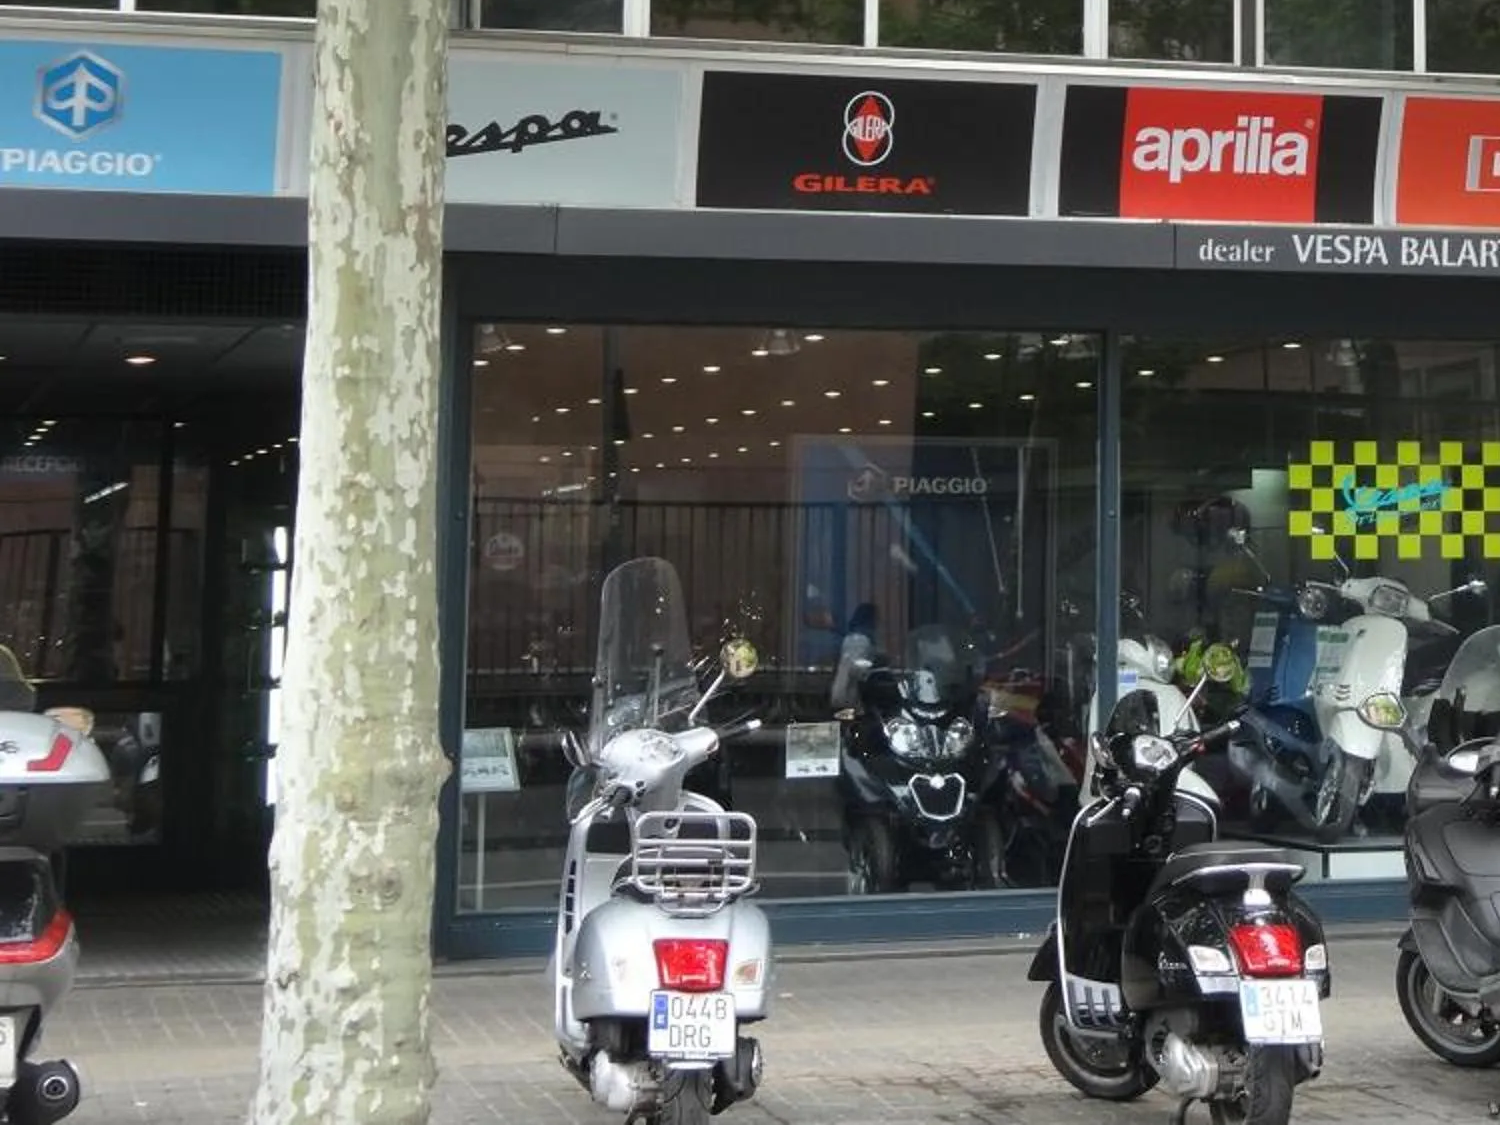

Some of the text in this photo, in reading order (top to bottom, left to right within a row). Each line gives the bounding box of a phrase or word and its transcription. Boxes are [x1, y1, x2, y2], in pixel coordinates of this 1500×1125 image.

[446, 111, 618, 157] espa
[1, 148, 155, 177] PIAGGIO
[1133, 115, 1309, 183] aprilia
[793, 173, 931, 195] GILERA
[1199, 238, 1276, 263] dealer
[1292, 234, 1390, 266] VESPA
[892, 475, 988, 495] PIAGGIO
[669, 1024, 711, 1048] DRG
